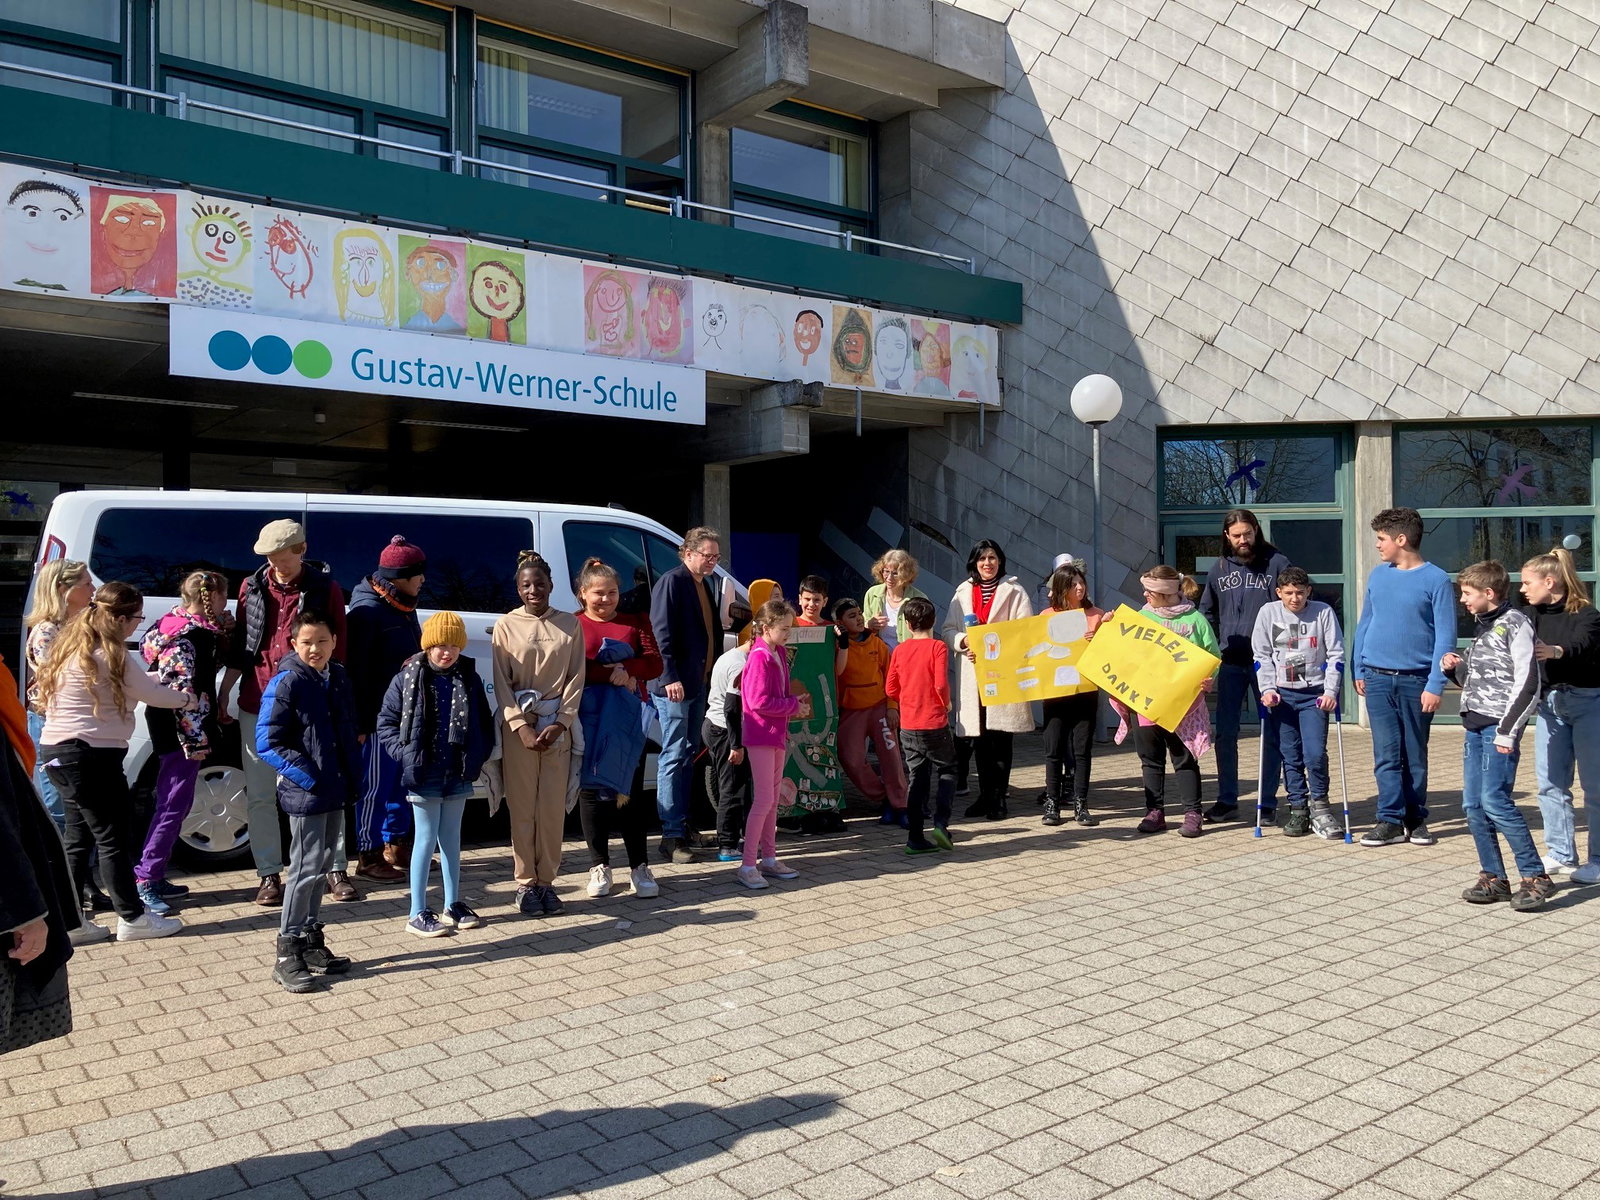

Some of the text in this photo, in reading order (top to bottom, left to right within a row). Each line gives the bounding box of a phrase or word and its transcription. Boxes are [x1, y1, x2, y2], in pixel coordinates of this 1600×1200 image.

[351, 347, 678, 411] Gustav-Werner-Schule
[1120, 622, 1189, 663] VIELEN
[879, 717, 897, 750] FILA
